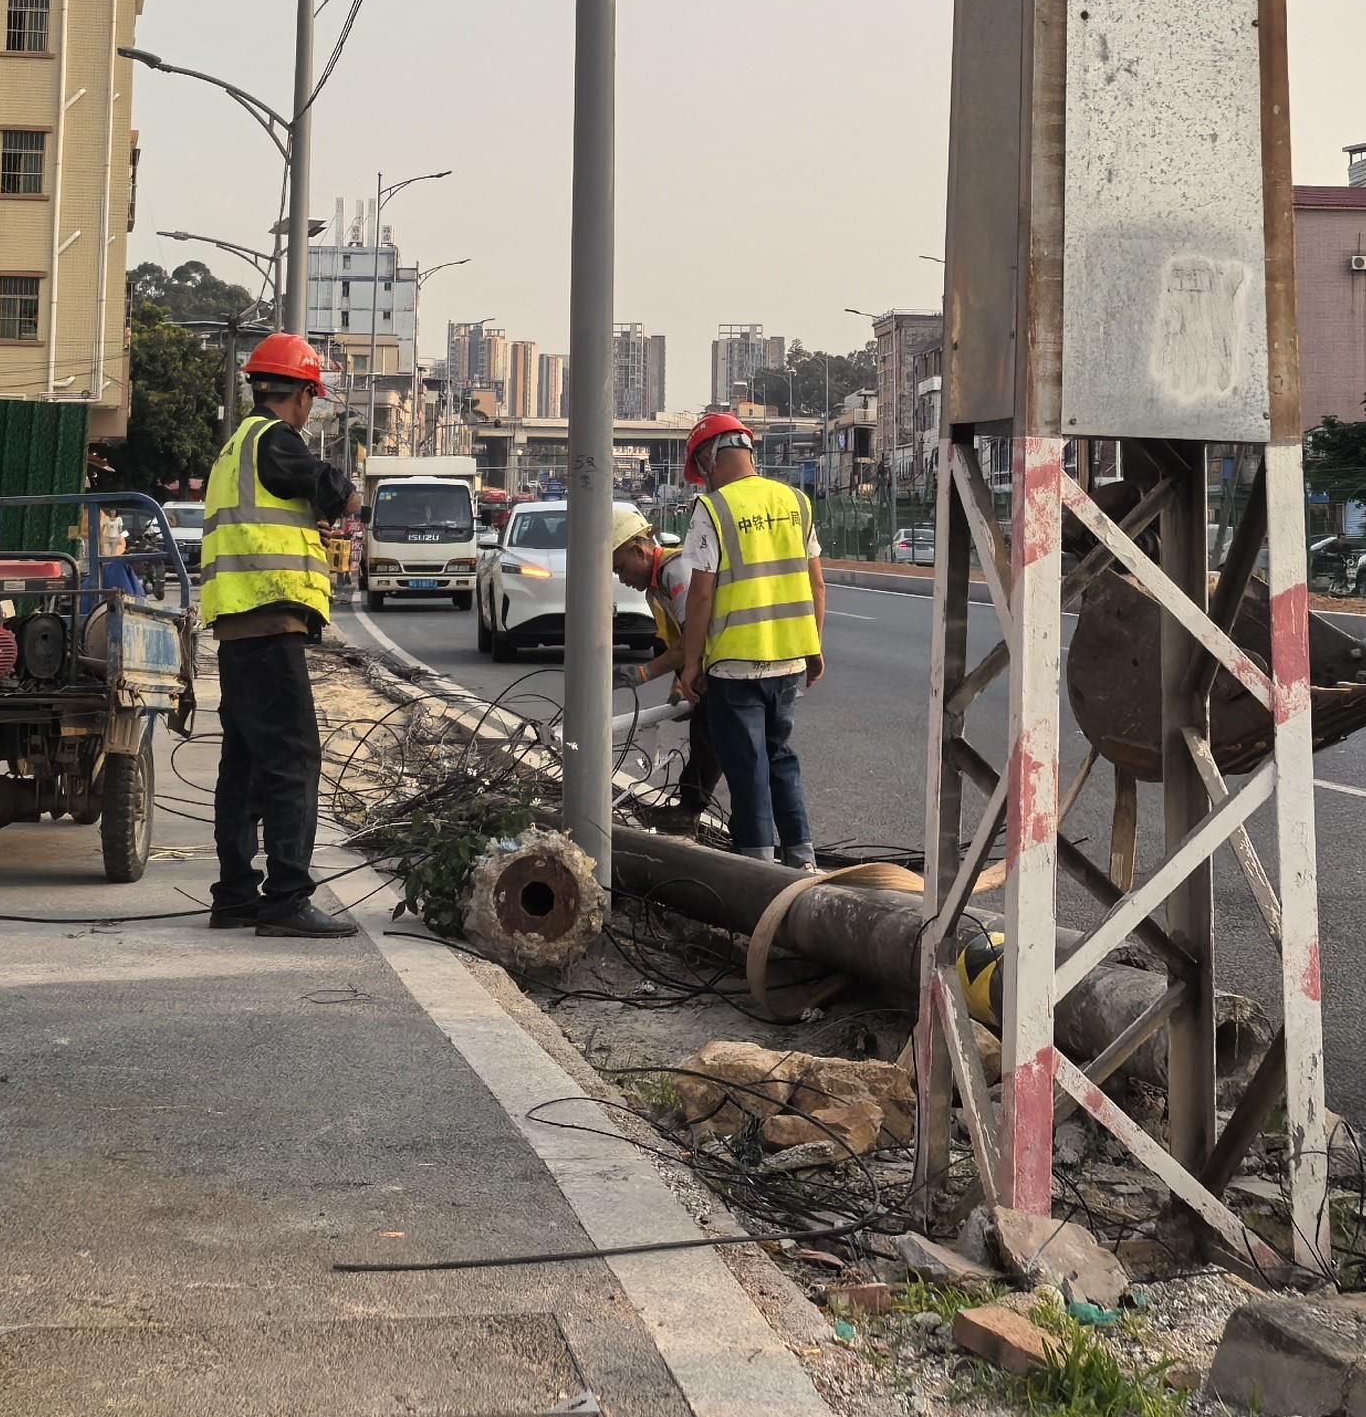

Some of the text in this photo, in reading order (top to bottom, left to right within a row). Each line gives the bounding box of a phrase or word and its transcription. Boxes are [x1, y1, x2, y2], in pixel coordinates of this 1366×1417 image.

[738, 510, 802, 534] 中铁十一局
